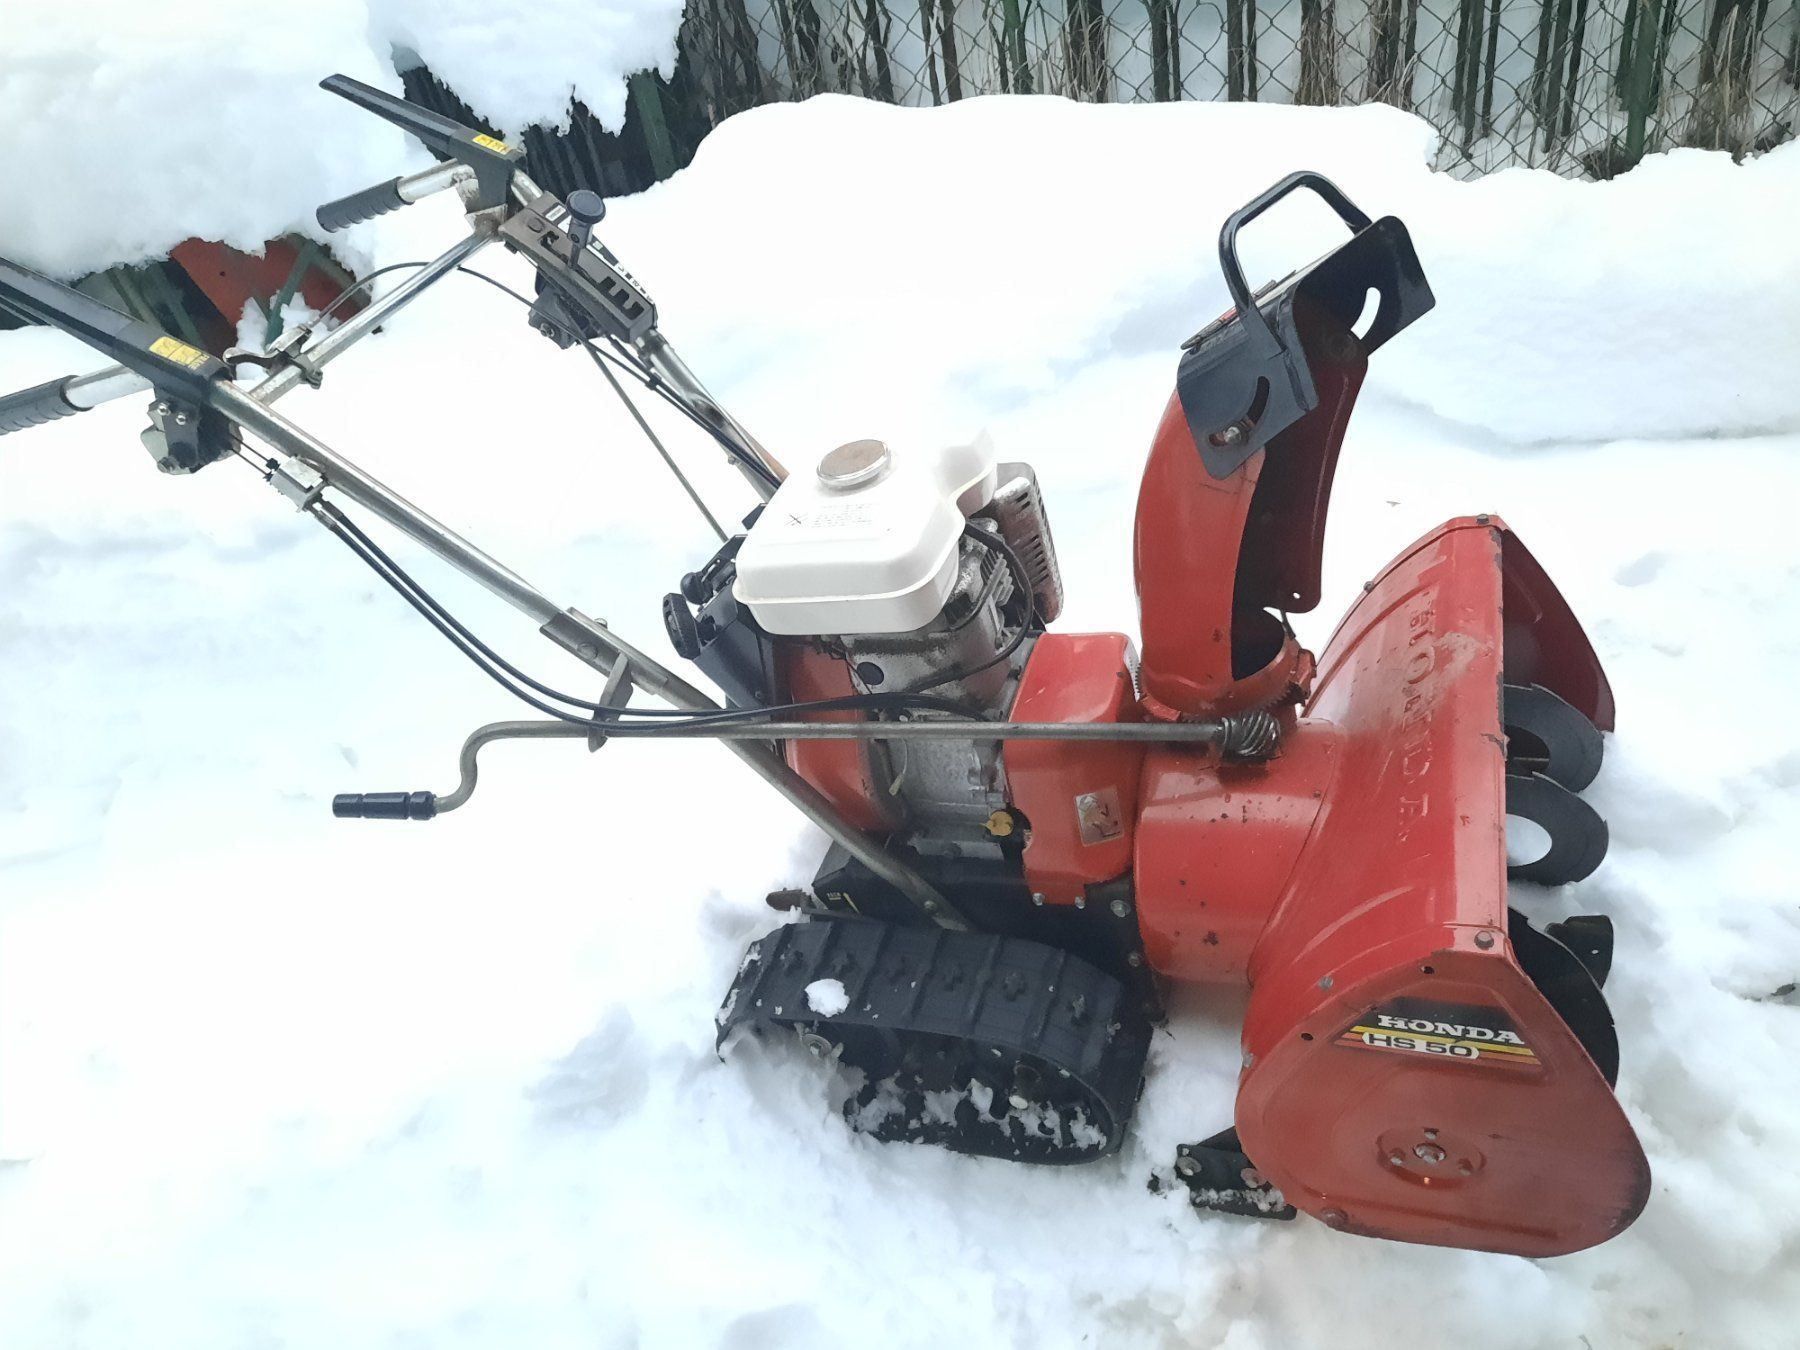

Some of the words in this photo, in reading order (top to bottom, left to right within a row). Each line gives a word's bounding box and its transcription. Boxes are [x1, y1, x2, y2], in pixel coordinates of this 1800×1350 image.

[1377, 1014, 1525, 1045] HONDA
[1368, 1033, 1416, 1050] HS
[1425, 1042, 1473, 1058] 50
